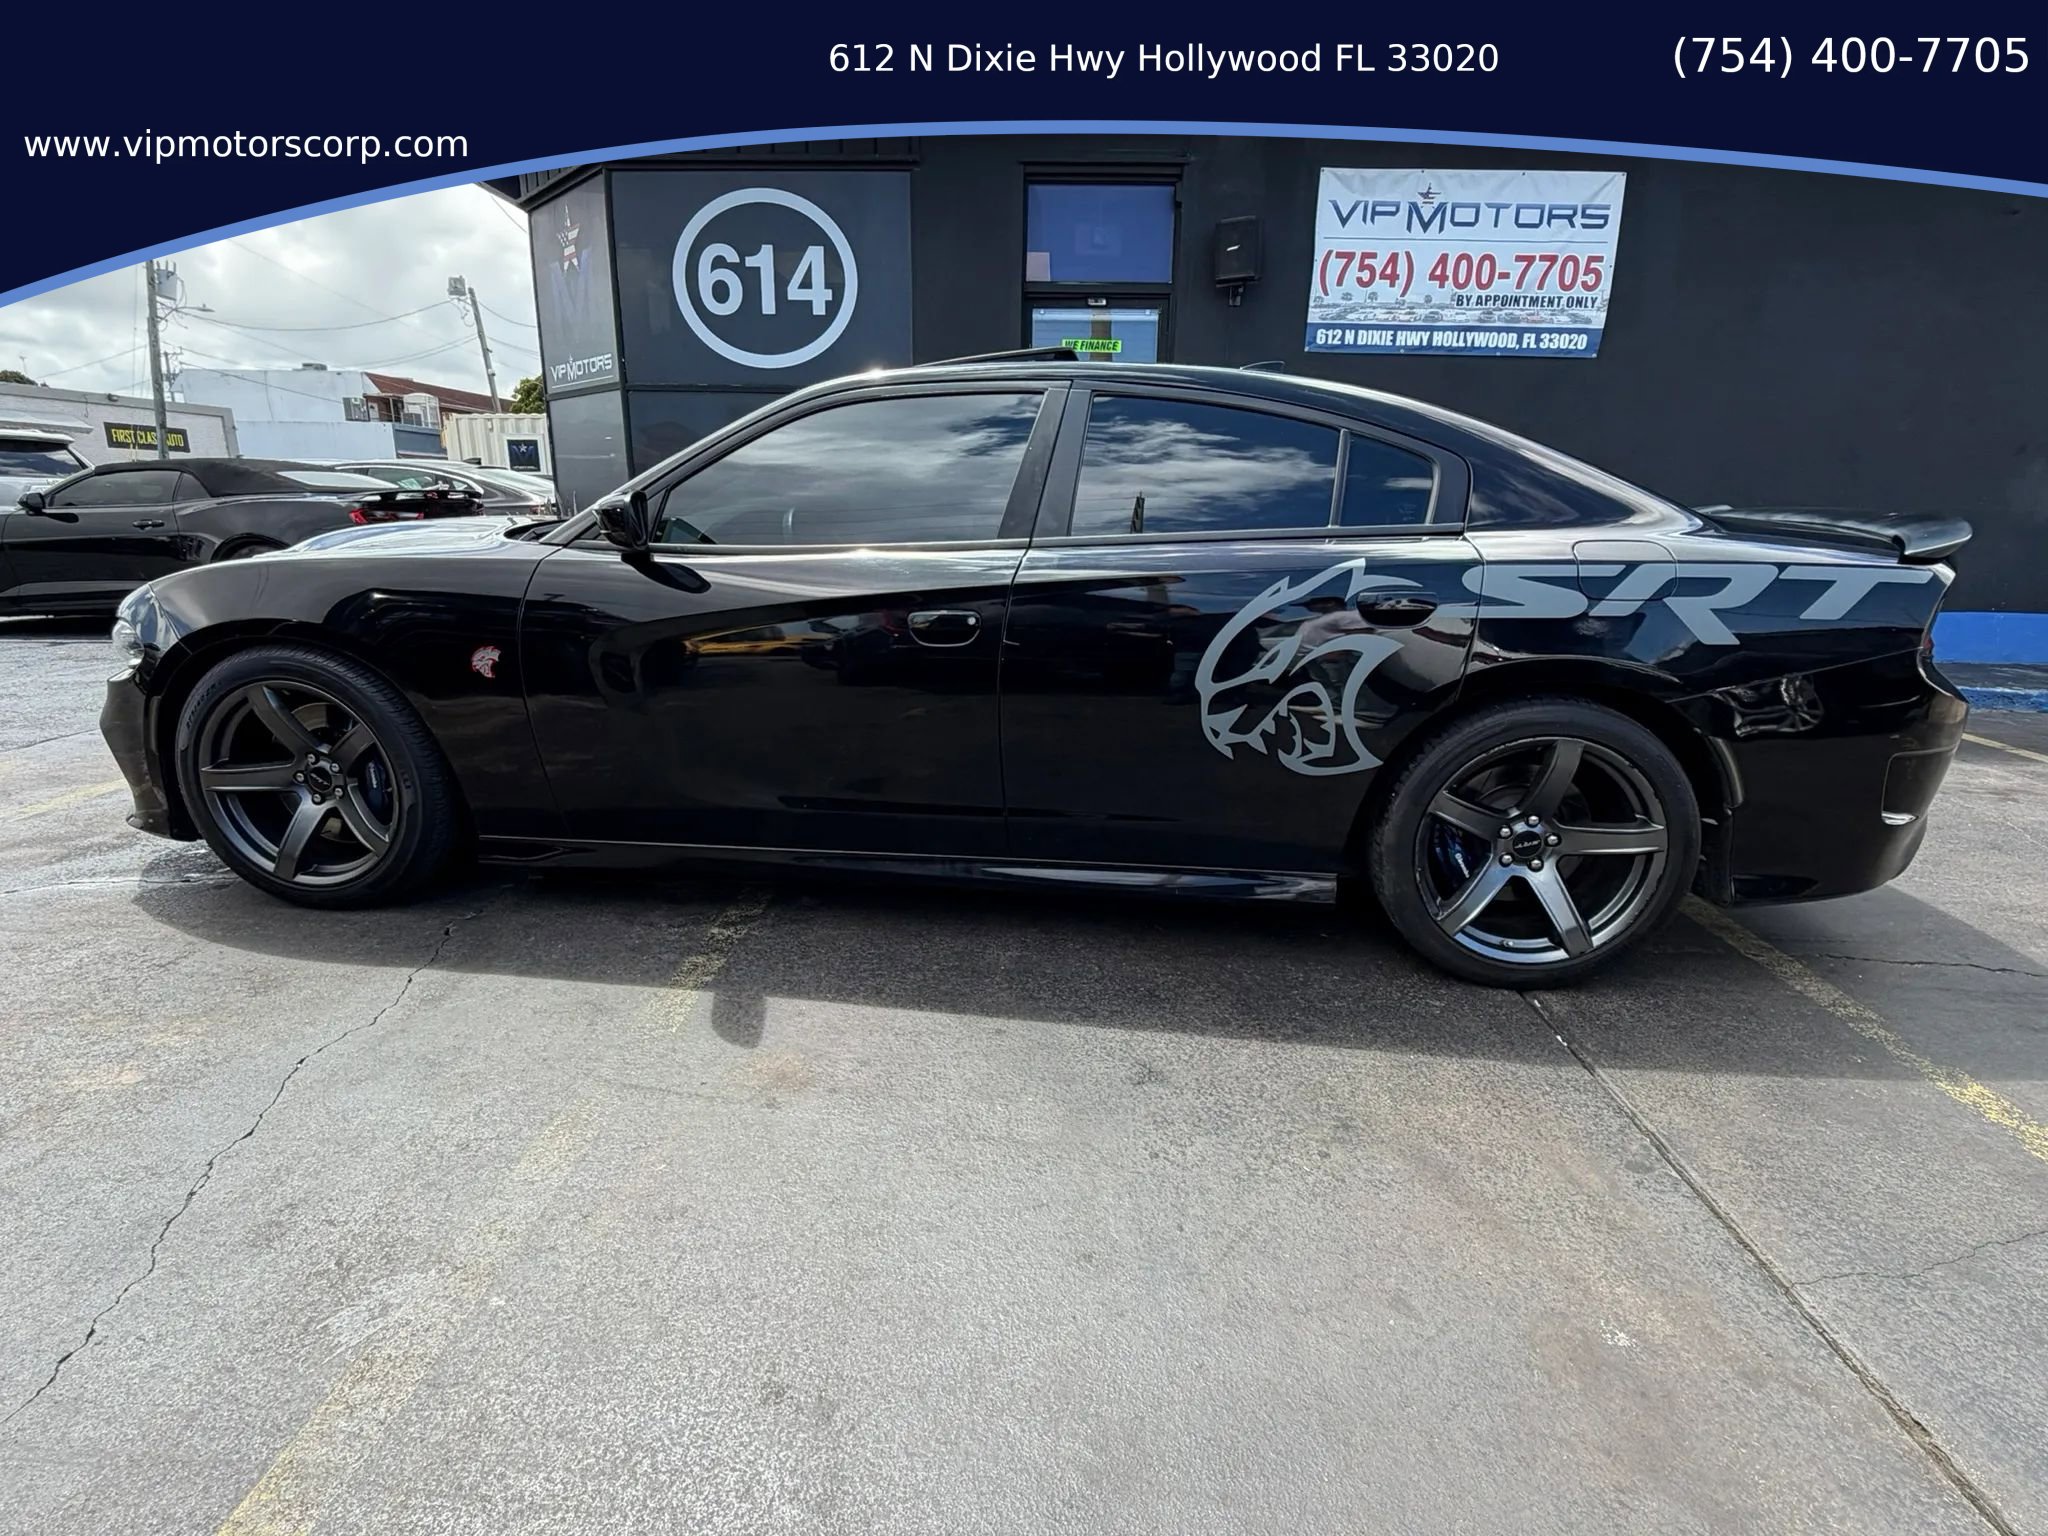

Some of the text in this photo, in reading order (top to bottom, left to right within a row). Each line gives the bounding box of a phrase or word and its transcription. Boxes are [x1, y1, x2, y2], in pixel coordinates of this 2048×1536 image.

[697, 242, 833, 317] 614
[1319, 249, 1605, 298] (754) 400-7705
[1456, 294, 1599, 309] BY APPOINTMENT ONLY
[1064, 340, 1120, 351] WE FINANCE
[1316, 328, 1589, 350] 612 N DIXIE HWY HOLLYWOOD, FL 33020
[111, 428, 136, 443] FIRST
[136, 431, 158, 445] CLAS
[1433, 562, 1935, 646] SRT
